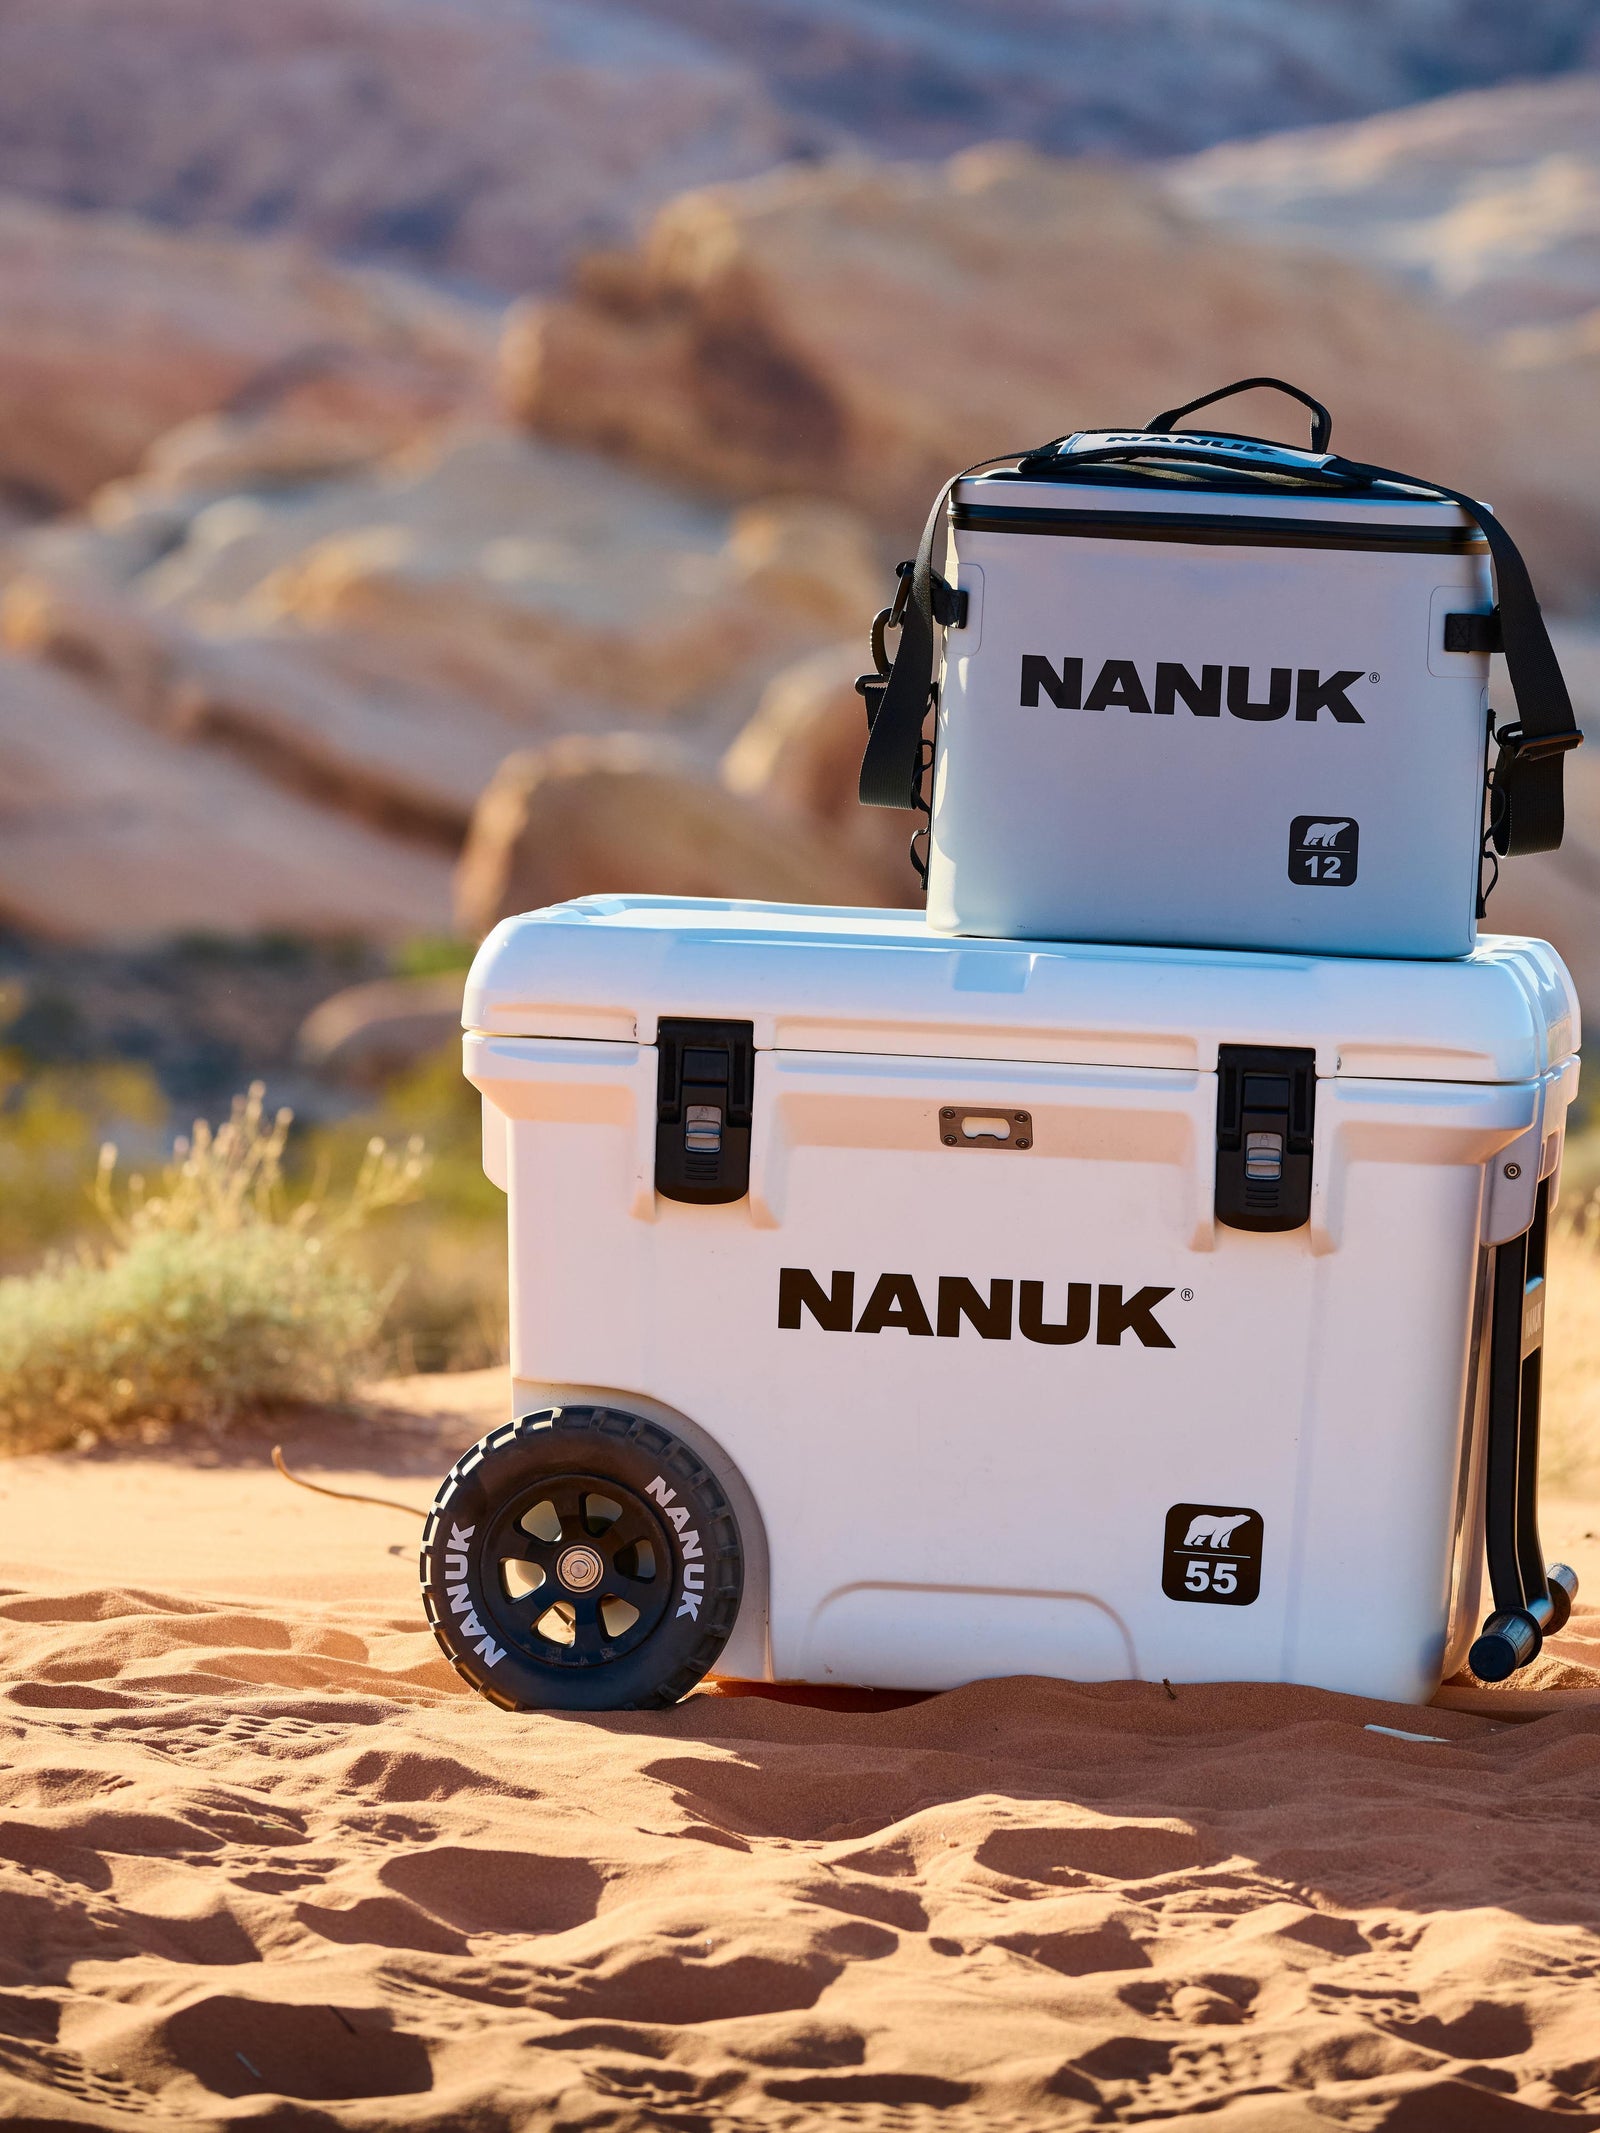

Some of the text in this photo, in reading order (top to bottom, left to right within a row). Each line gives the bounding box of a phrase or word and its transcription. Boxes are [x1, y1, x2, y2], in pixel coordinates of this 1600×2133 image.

[1105, 436, 1277, 456] NANUK
[1304, 855, 1342, 879] 12
[644, 1475, 705, 1622] NANUK
[1184, 1560, 1238, 1594] 55
[444, 1521, 508, 1668] NANUK
